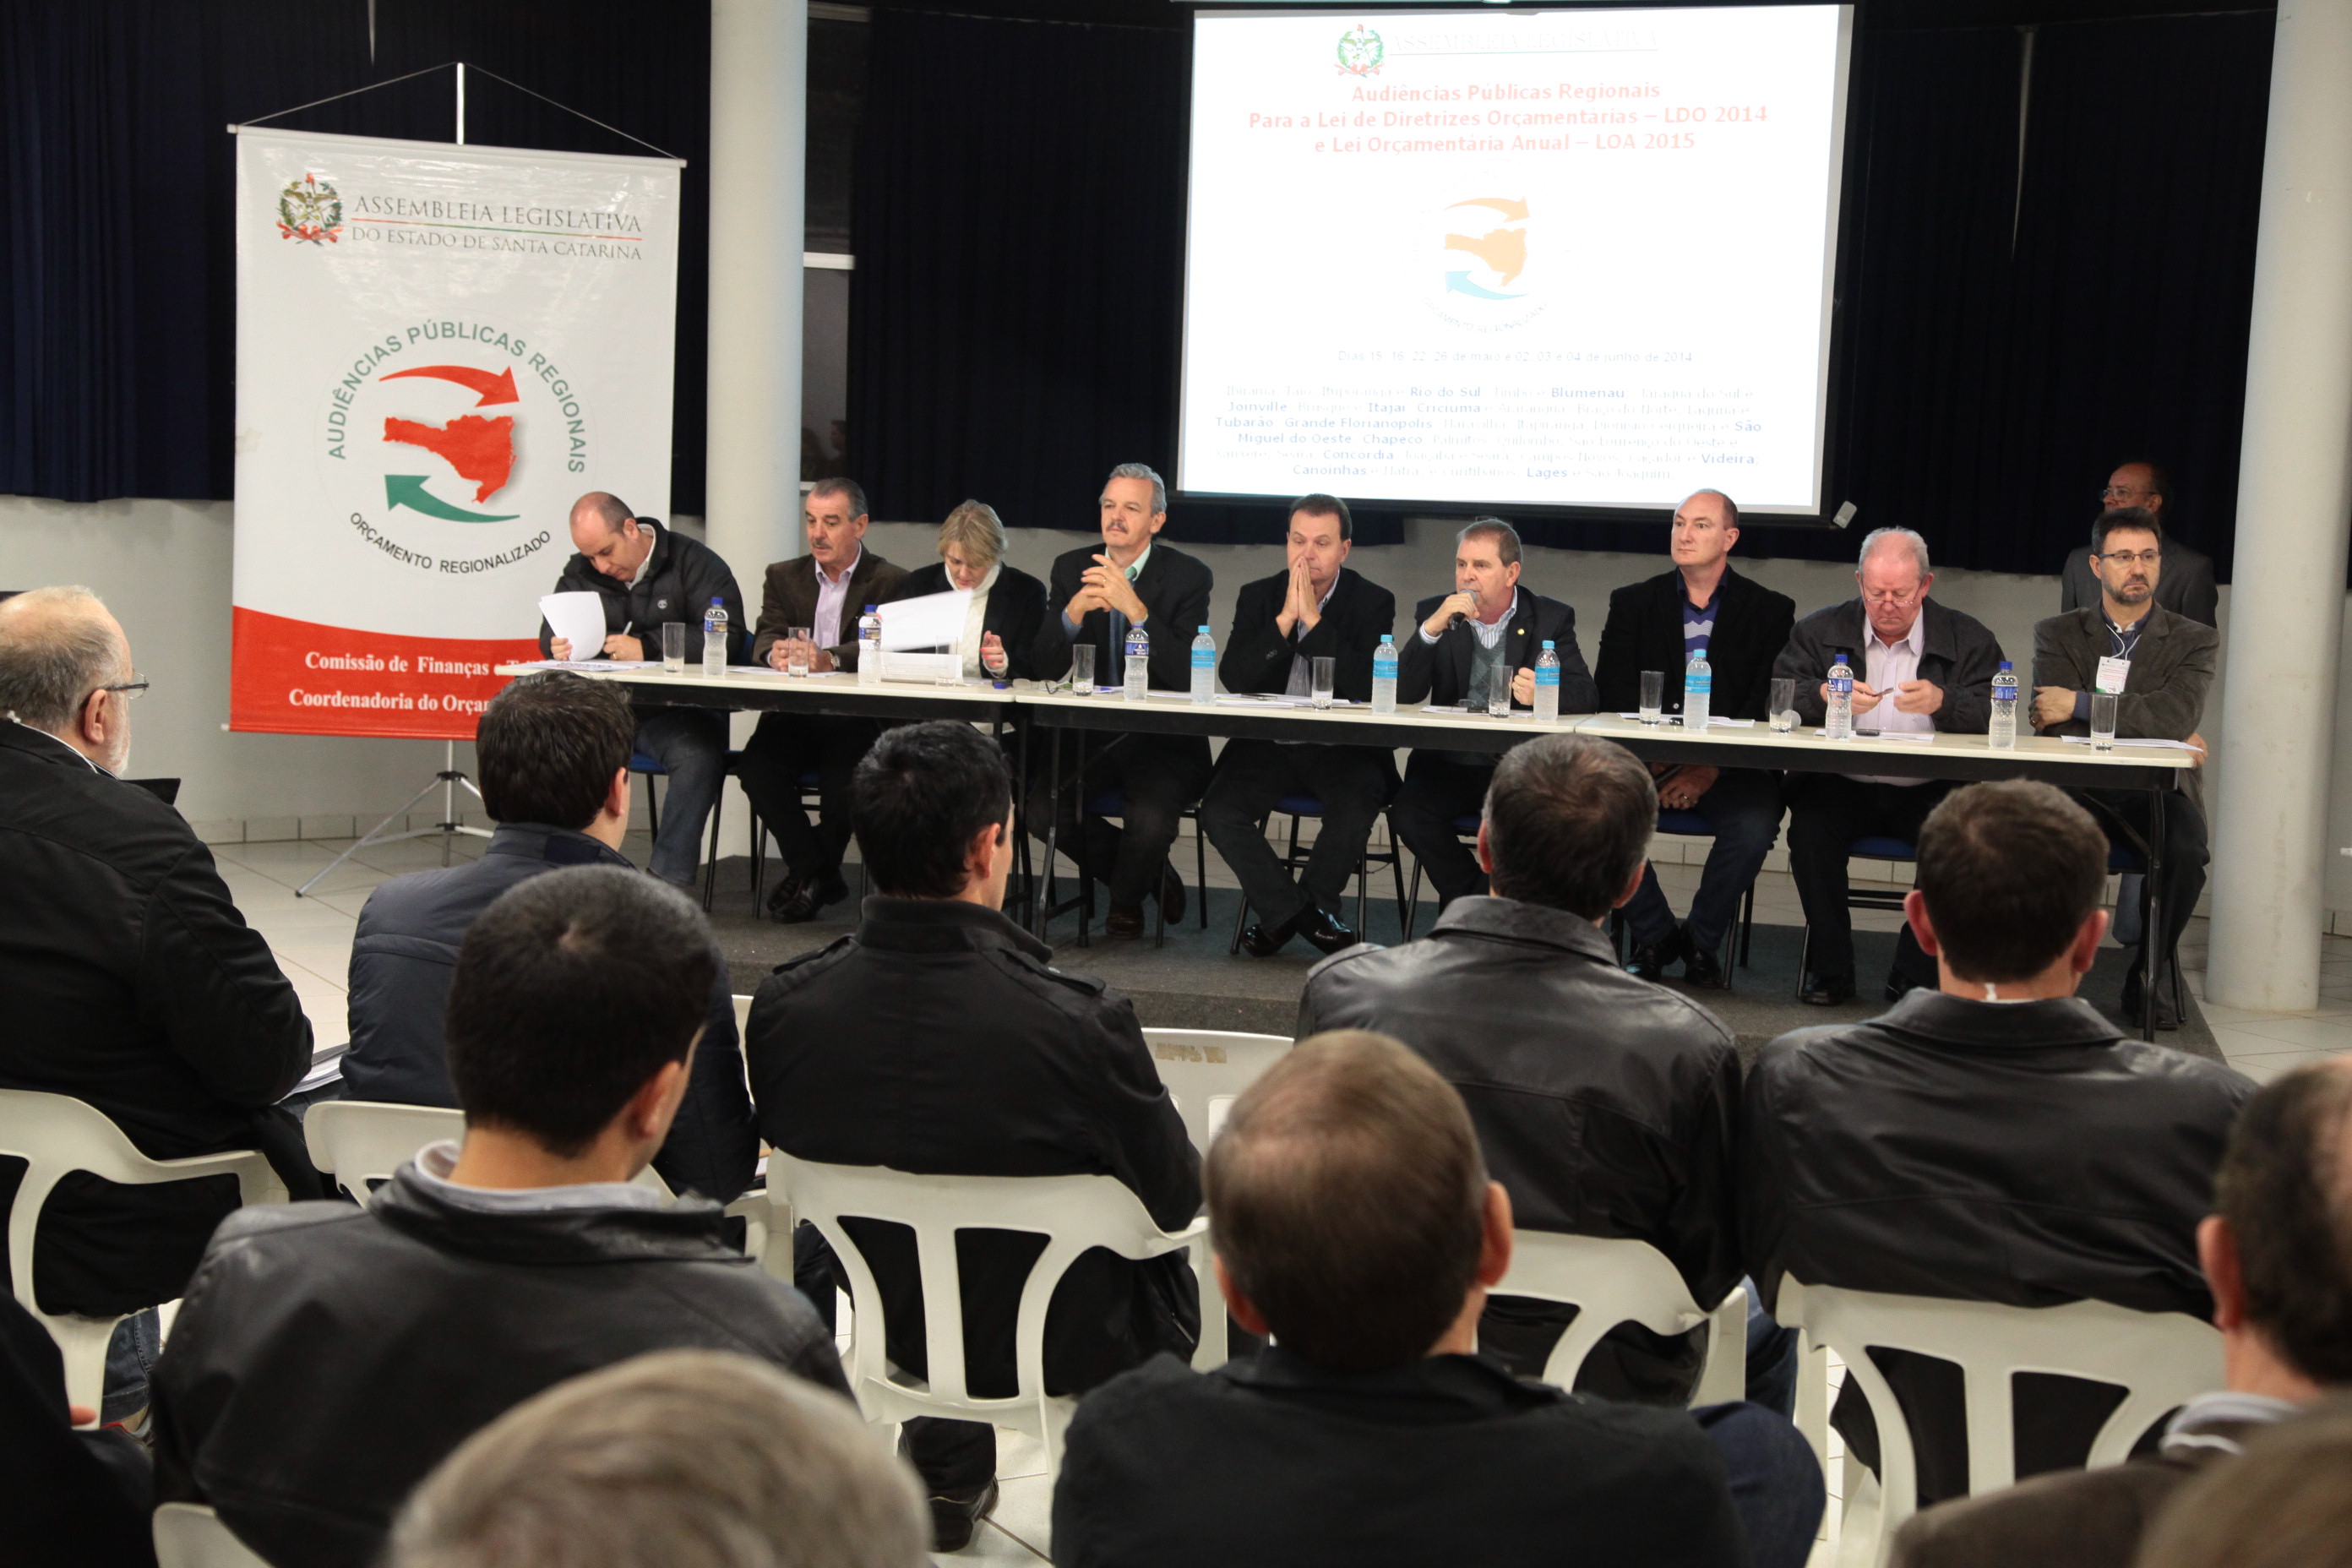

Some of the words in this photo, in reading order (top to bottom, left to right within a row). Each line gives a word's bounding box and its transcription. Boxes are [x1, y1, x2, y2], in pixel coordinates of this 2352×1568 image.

[1352, 84, 1462, 102] Audiências
[1467, 82, 1552, 101] Públicas
[1559, 81, 1661, 103] Regionais
[1249, 112, 1293, 128] Para
[1299, 115, 1311, 128] a
[1317, 112, 1347, 128] Lei
[1353, 111, 1377, 128] de
[1384, 110, 1481, 128] Diretrizes
[1487, 106, 1638, 130] Orçamentárias
[1664, 106, 1707, 124] LDO
[1714, 105, 1768, 123] 2014
[1315, 141, 1326, 153] e
[1332, 137, 1362, 153] Lei
[1368, 134, 1505, 156] Orçamentária
[1511, 133, 1570, 151] Anual
[1596, 133, 1636, 150] LOA
[1644, 132, 1696, 150] 2015
[355, 195, 493, 222] ASSEMBLEIA
[503, 206, 642, 232] LEGISLATIVA
[352, 226, 381, 242] DO
[388, 229, 457, 248] ESTADO
[463, 235, 487, 250] DE
[492, 237, 549, 254] SANTA
[553, 241, 642, 261] CATARINA
[1663, 351, 1693, 362] 2014
[327, 335, 403, 460] AUDIÊNCIAS
[406, 318, 526, 357] PÚBLICAS
[527, 351, 587, 474] REGIONAIS
[1410, 386, 1433, 398] Rio
[1437, 386, 1455, 398] do
[1284, 416, 1337, 428] Grande
[1734, 419, 1762, 432] São
[1238, 433, 1284, 445] Miguel
[1288, 433, 1307, 444] do
[1293, 464, 1367, 476] Canoinhas
[1527, 467, 1568, 480] Lages
[350, 512, 433, 569] ORÇAMENTO
[439, 531, 551, 574] REGIONALIZADO
[305, 651, 385, 672] Comissão
[388, 656, 409, 673] de
[417, 656, 490, 679] Finanças
[289, 689, 414, 710] Coordenadoria
[417, 694, 439, 711] do
